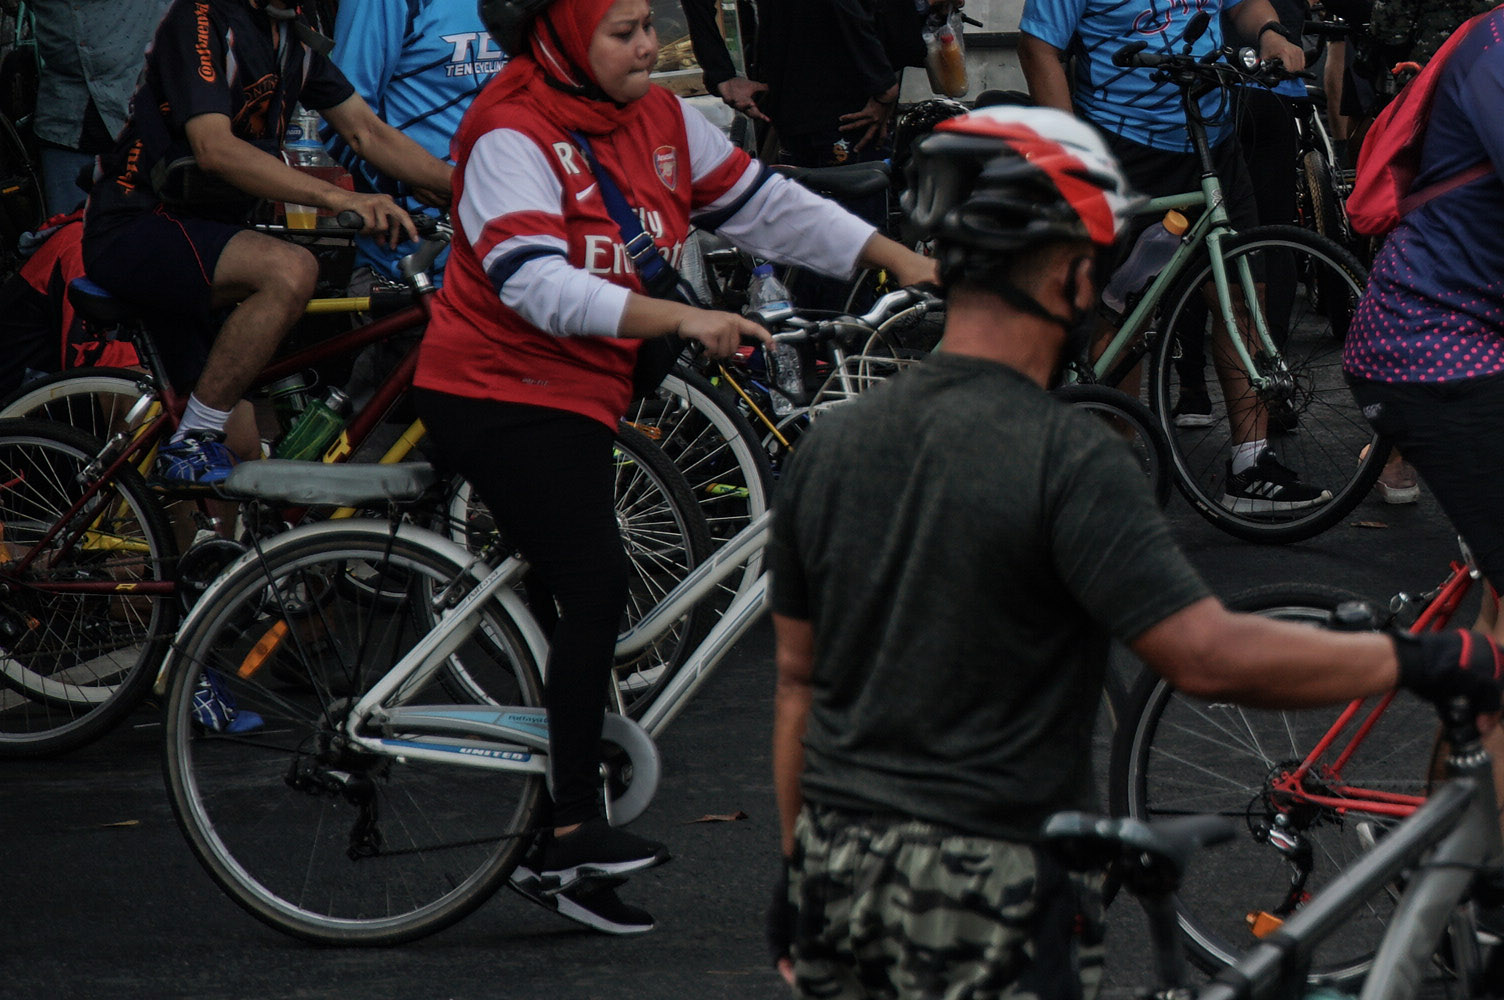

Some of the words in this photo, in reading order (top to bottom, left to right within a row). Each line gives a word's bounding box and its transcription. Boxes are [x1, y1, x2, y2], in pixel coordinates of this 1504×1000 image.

[445, 62, 473, 77] TEN
[473, 60, 509, 75] CYCLIN
[459, 747, 524, 761] UNITED
